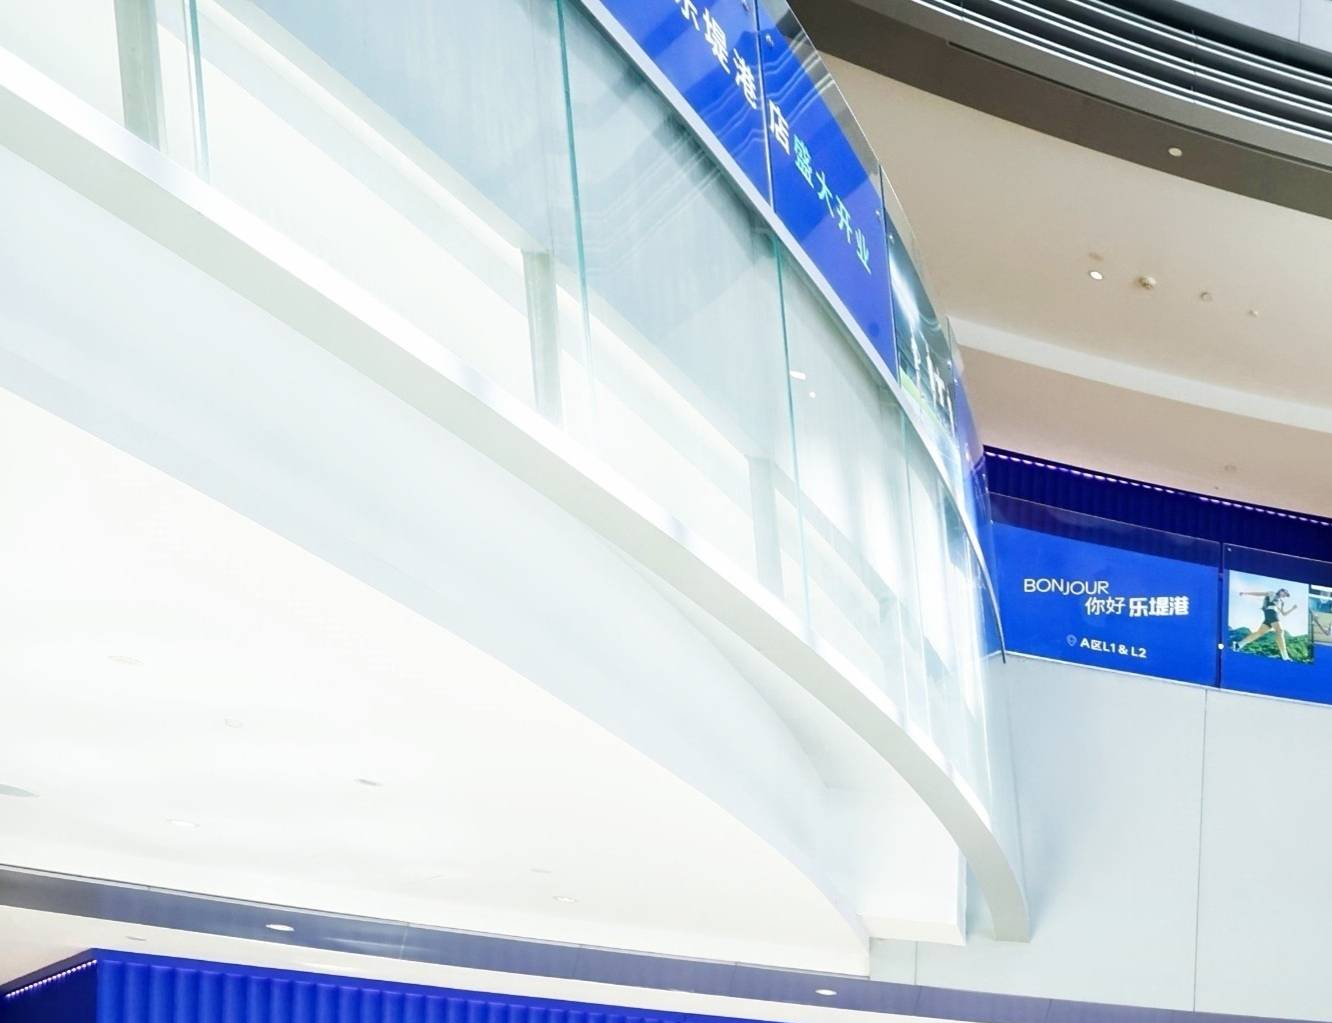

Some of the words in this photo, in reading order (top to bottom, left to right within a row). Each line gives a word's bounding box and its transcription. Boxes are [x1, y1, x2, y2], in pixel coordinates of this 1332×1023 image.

[1023, 578, 1110, 597] BONJOUR
[1085, 597, 1124, 617] 你好
[1128, 596, 1190, 618] 乐堤港
[1131, 646, 1147, 659] L2
